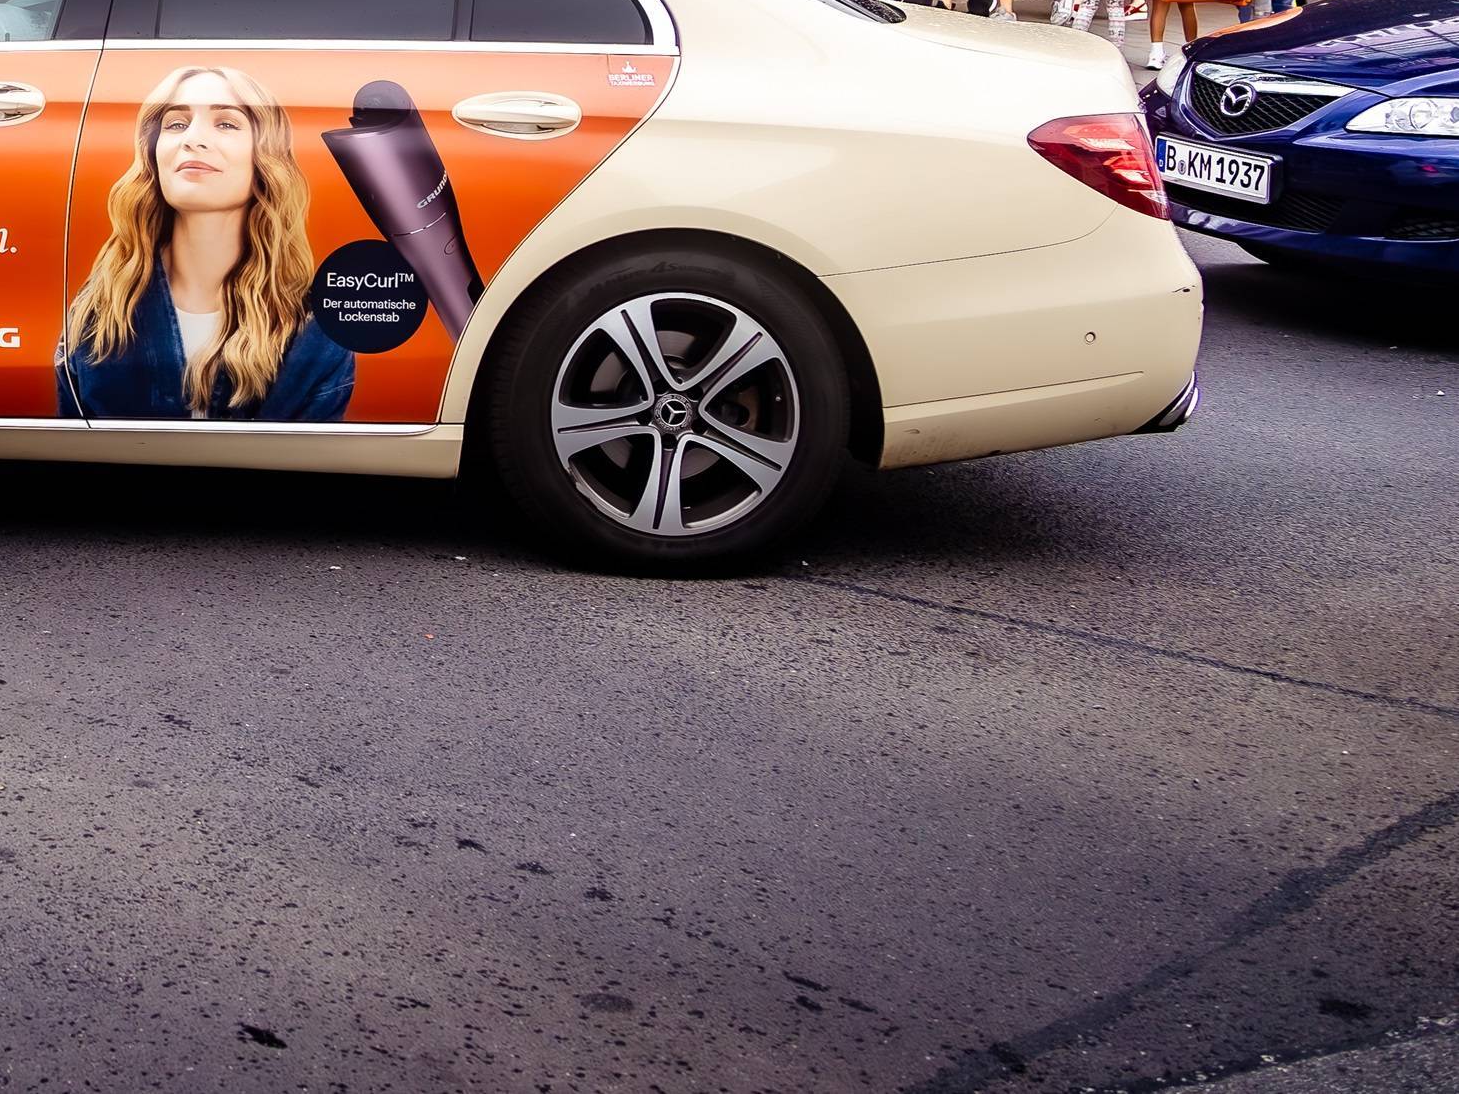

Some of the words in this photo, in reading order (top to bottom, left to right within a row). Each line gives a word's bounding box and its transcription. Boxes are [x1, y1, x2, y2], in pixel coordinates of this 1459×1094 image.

[1166, 145, 1177, 171] B
[1187, 150, 1212, 180] KM
[1215, 157, 1265, 191] 1937
[323, 298, 342, 309] Der
[344, 299, 416, 310] automatische
[339, 311, 400, 323] Lockenstab
